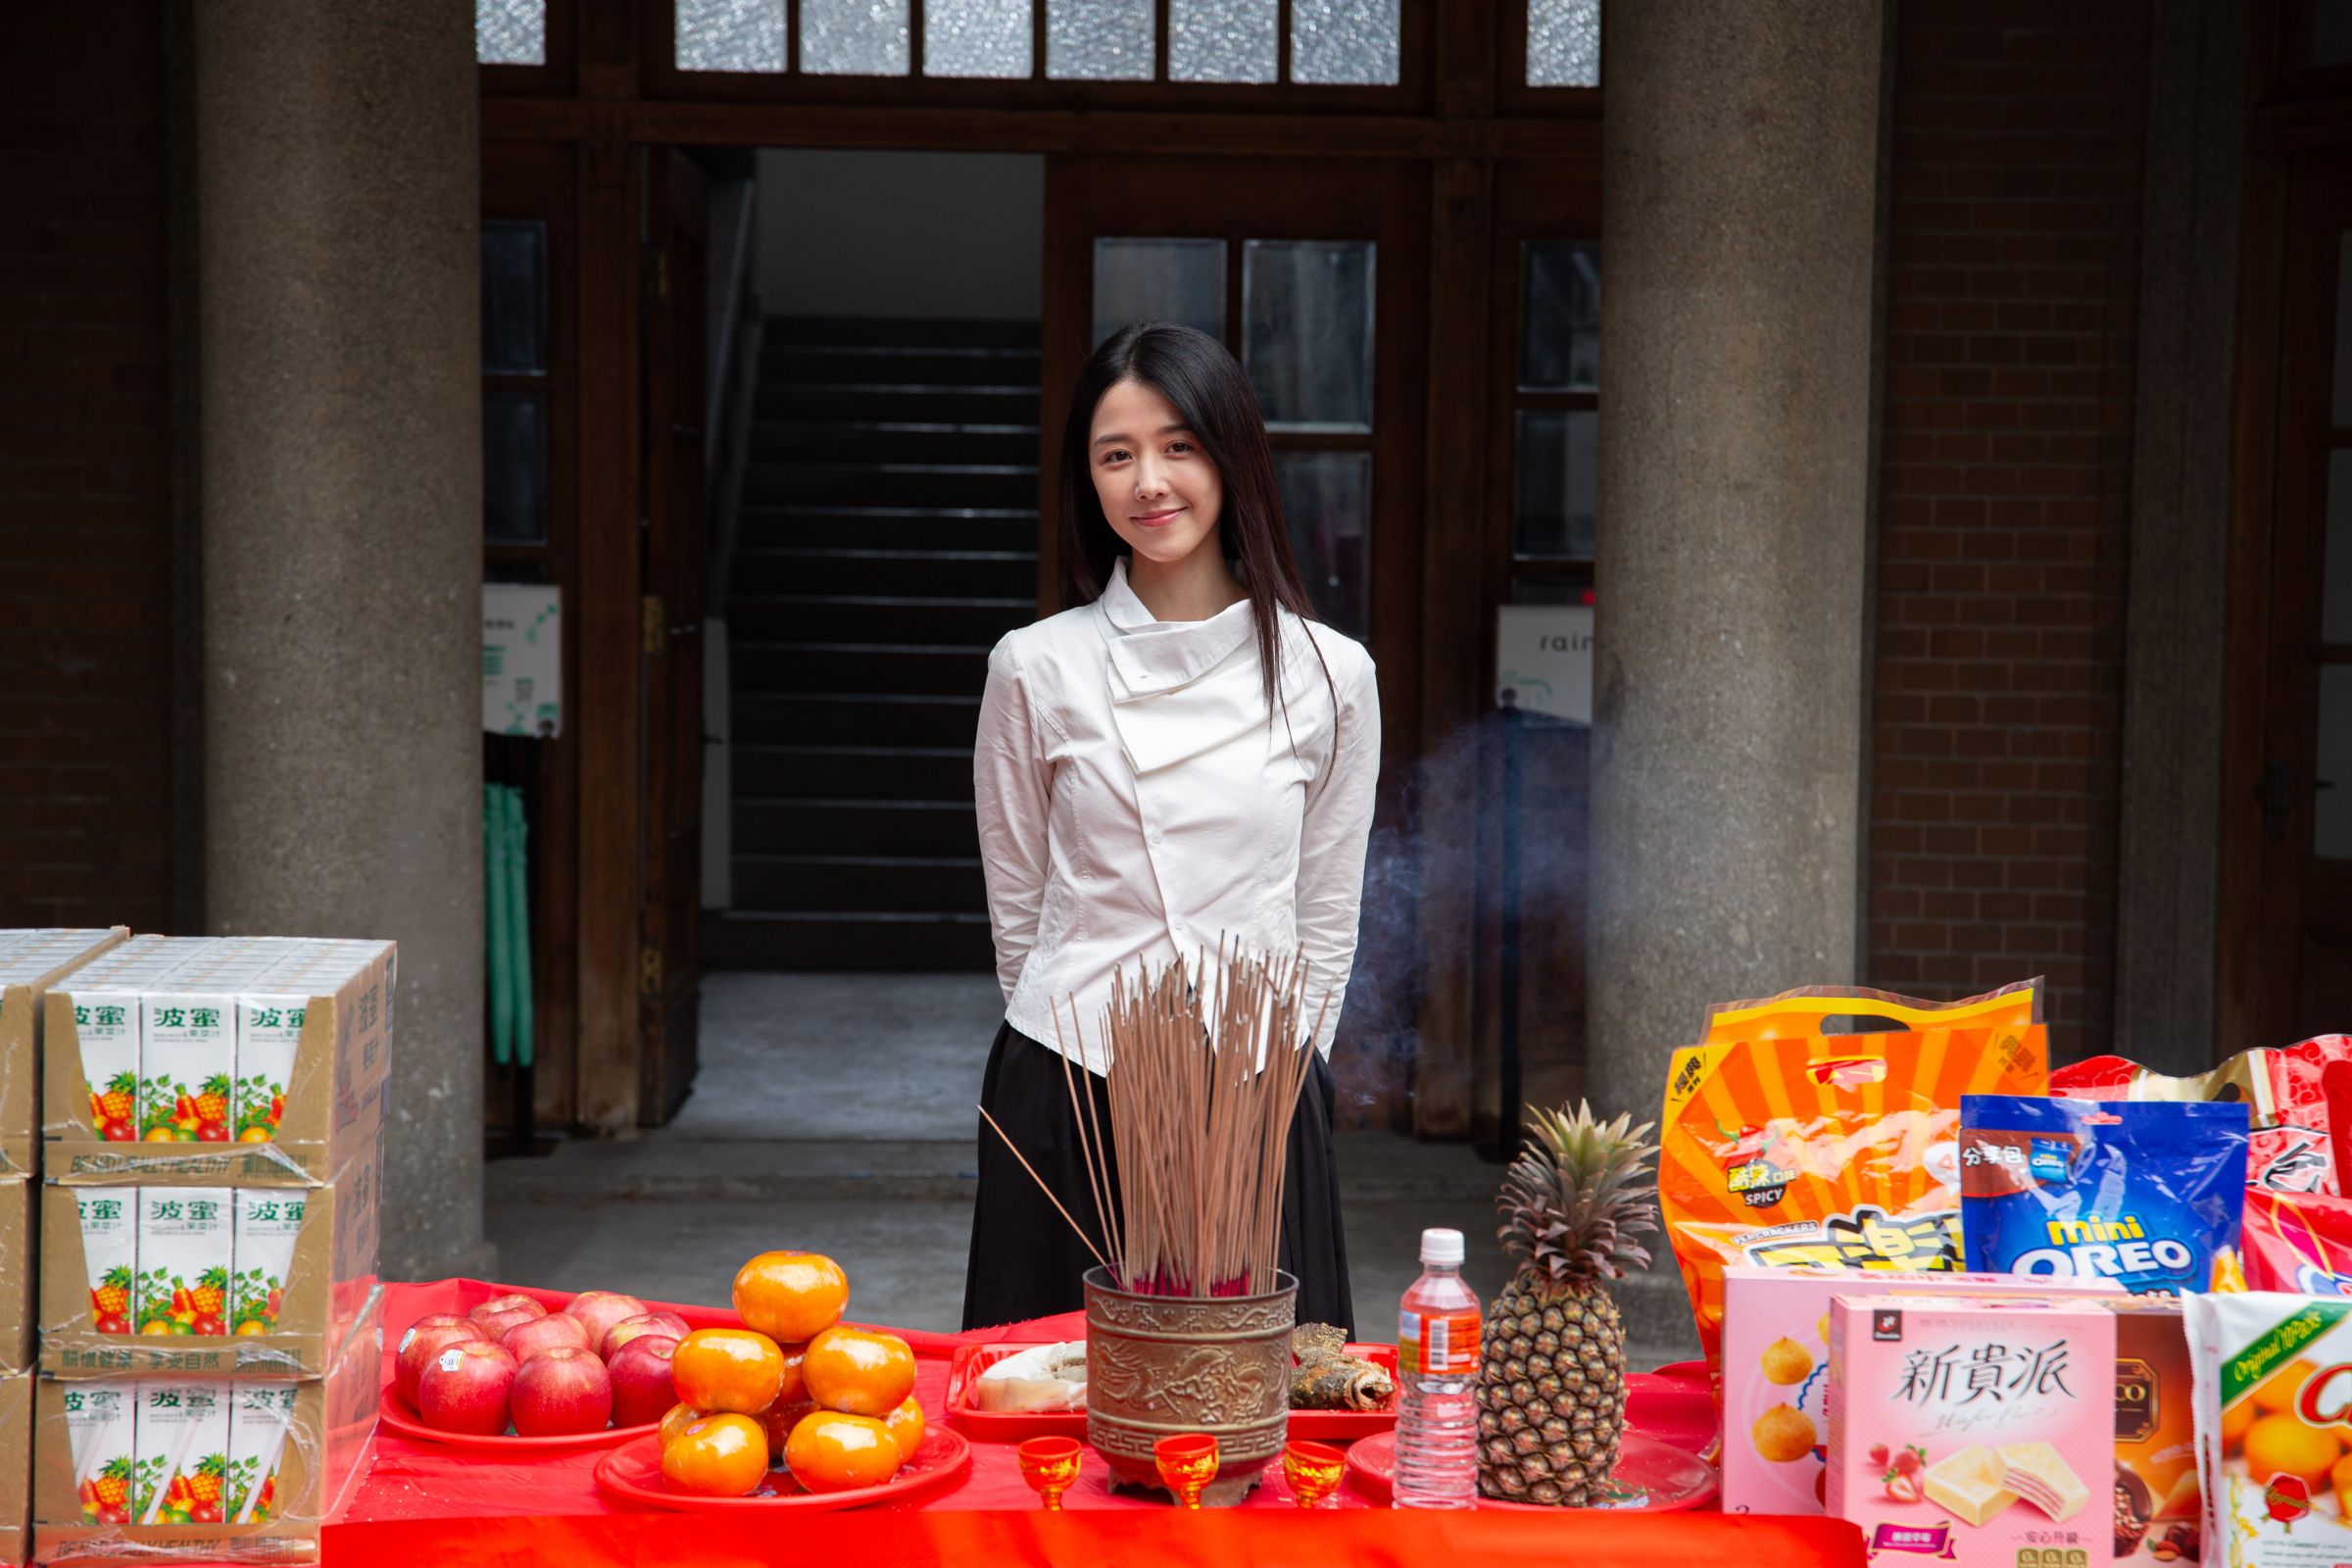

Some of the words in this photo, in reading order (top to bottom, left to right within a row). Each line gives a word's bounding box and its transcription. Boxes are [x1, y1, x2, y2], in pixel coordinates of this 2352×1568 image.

[153, 1006, 220, 1028] 波蜜
[1962, 1145, 2025, 1167] 分享包
[1744, 1188, 1784, 1206] SPICY
[78, 1200, 122, 1221] 蜜
[151, 1200, 218, 1221] 波蜜
[2045, 1215, 2145, 1247] mini
[2011, 1239, 2193, 1277] OREO
[1888, 1339, 2078, 1410] 新貴派
[150, 1389, 216, 1408] 波蜜
